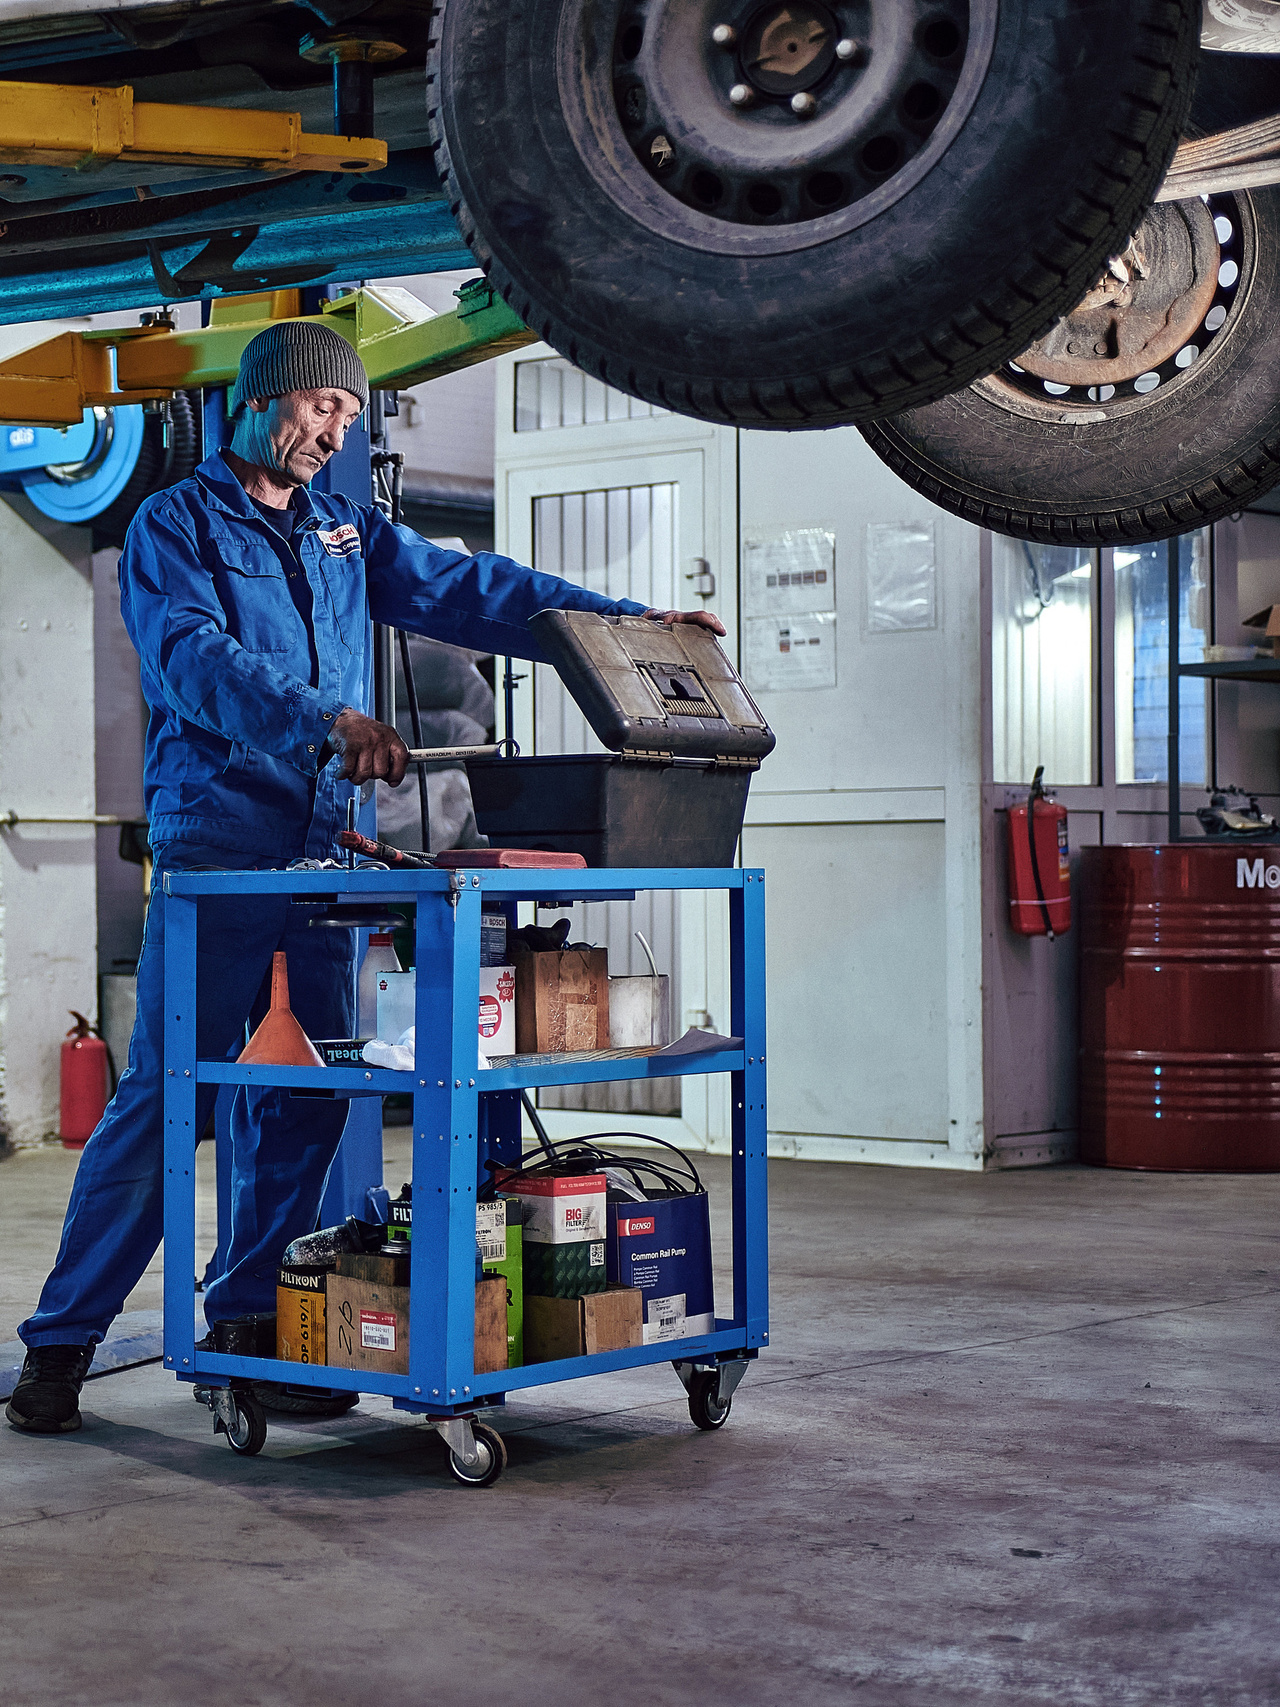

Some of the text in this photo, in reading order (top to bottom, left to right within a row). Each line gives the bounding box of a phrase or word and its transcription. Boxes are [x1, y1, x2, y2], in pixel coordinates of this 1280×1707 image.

[489, 918, 506, 927] BOSCH
[487, 1202, 503, 1211] 985/5
[393, 1207, 412, 1222] FILT
[565, 1208, 582, 1220] BIG
[565, 1219, 585, 1228] FILTER
[631, 1222, 651, 1231] DENSO
[631, 1248, 686, 1261] Common Rail Pump
[280, 1271, 318, 1288] FILTRON
[300, 1298, 309, 1364] OP 619/1
